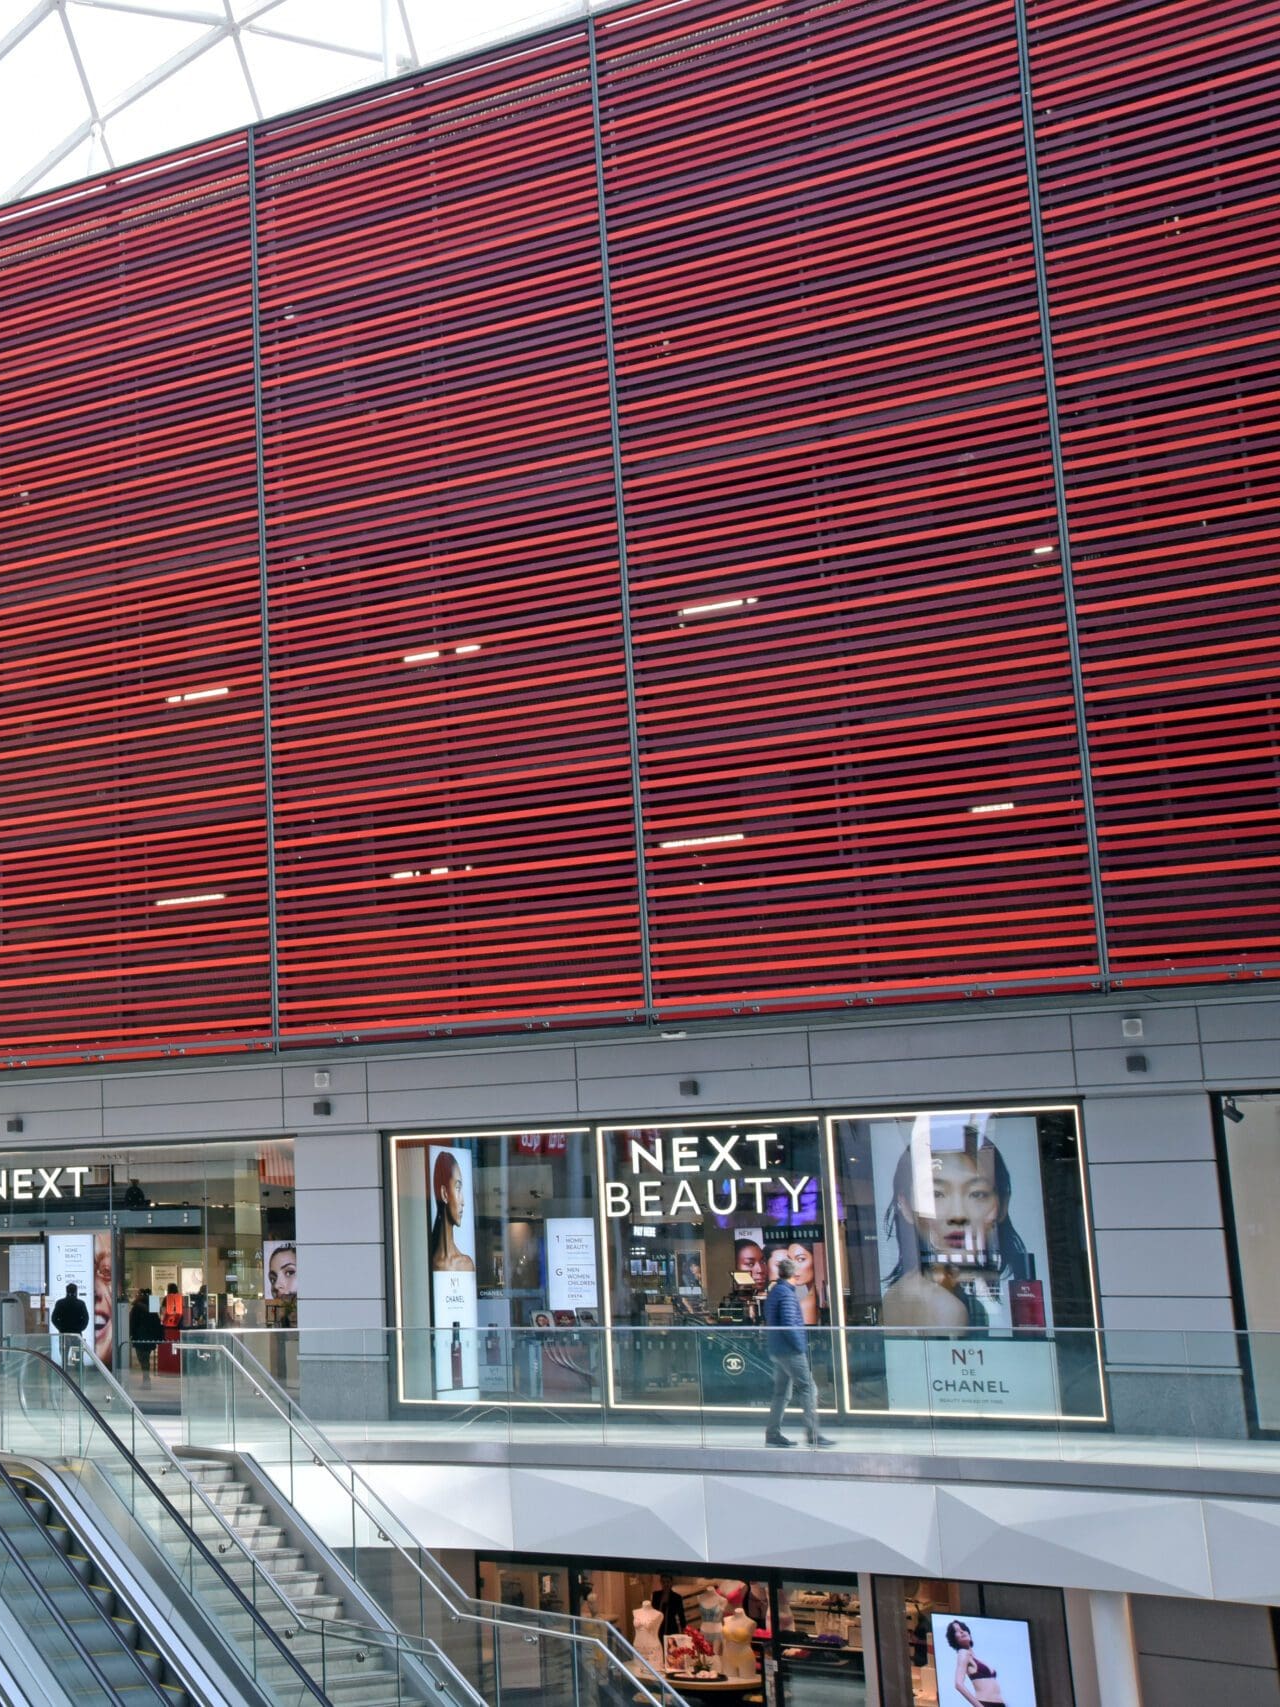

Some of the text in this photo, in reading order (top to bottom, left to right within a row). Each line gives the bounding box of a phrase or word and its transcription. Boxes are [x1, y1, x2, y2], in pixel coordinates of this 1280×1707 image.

[631, 1133, 778, 1174] NEXT
[605, 1176, 810, 1217] BEAUTY
[555, 1268, 563, 1277] G
[445, 1295, 465, 1303] CHANEL
[951, 1348, 984, 1366] N°1
[961, 1368, 976, 1376] DE
[932, 1379, 1010, 1393] CHANEL
